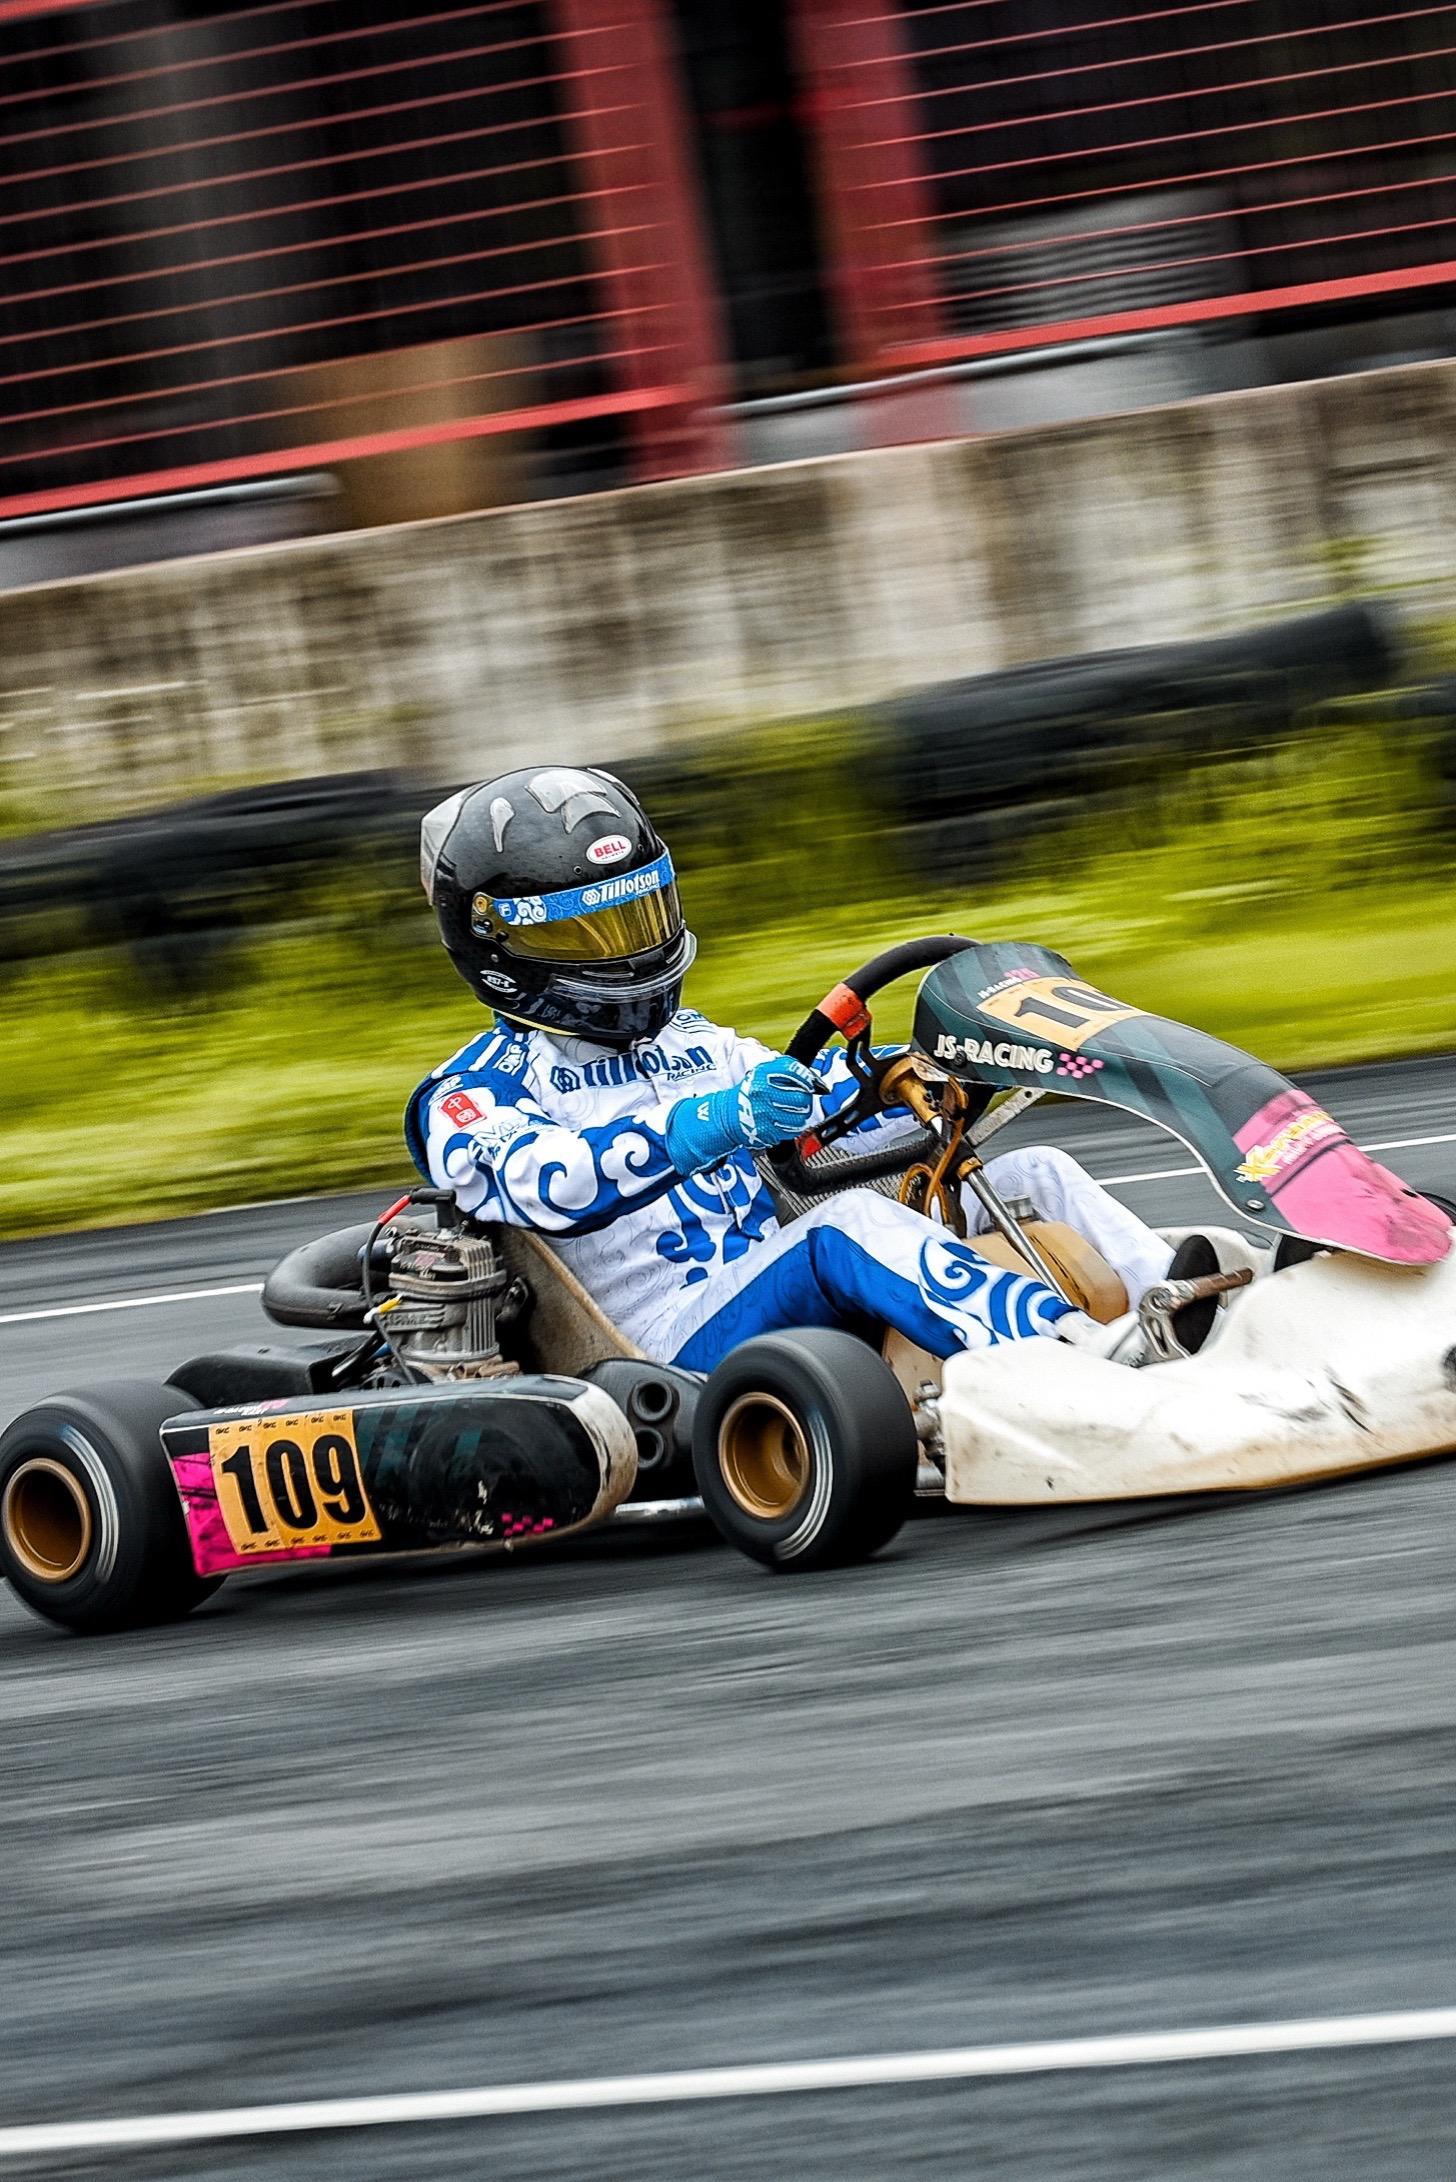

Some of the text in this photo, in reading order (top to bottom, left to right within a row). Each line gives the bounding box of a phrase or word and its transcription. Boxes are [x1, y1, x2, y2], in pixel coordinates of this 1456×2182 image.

[594, 841, 626, 859] BELL
[598, 870, 660, 902] Tillotson
[933, 1034, 1054, 1073] JS-RACING
[221, 1434, 366, 1534] 109
